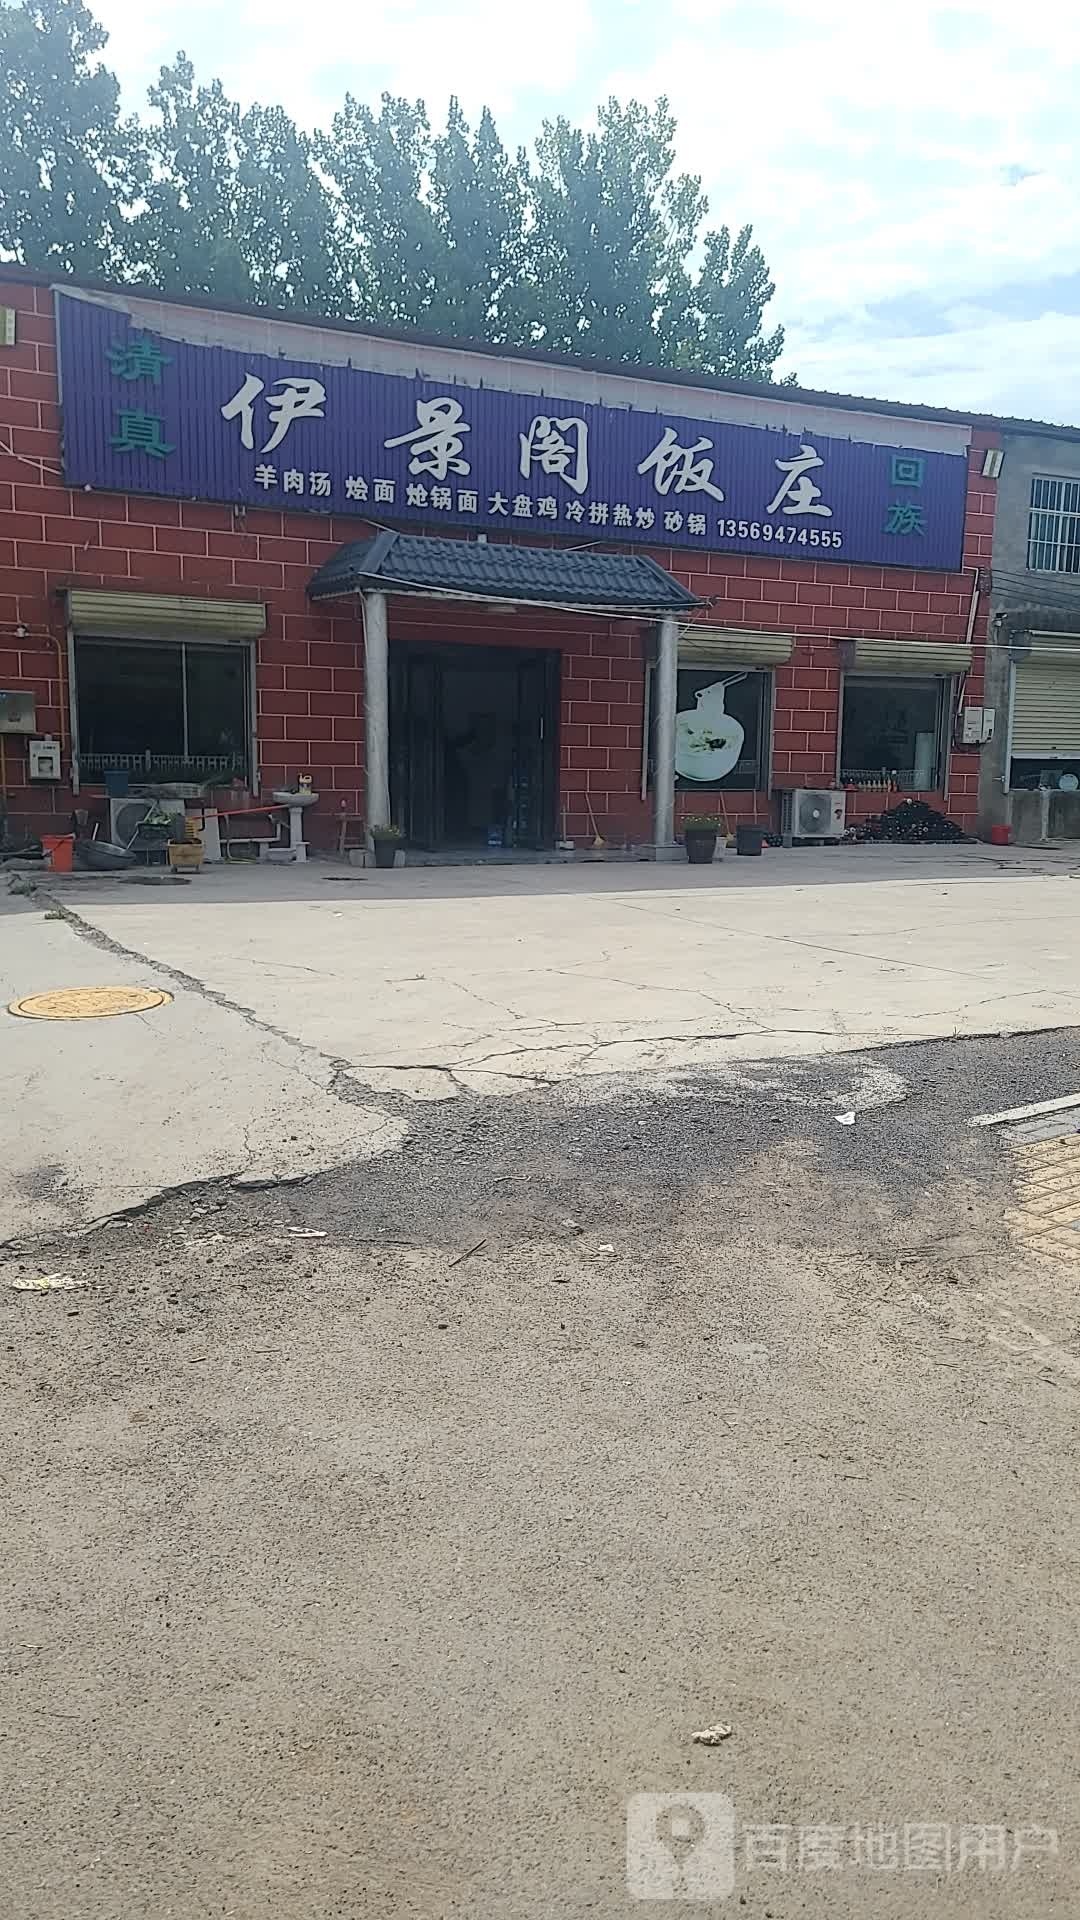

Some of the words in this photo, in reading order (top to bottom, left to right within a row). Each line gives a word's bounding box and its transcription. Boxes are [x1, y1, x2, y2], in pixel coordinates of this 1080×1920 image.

[106, 336, 174, 458] 清真
[221, 374, 833, 516] 伊景阁饭庄
[254, 464, 331, 496] 羊肉汤
[345, 475, 396, 503] 烩面
[488, 491, 558, 520] 大盘鸡
[565, 500, 655, 530] 冷拼热炒
[664, 510, 707, 536] 砂锅
[717, 519, 843, 549] 13569474555
[884, 455, 925, 536] 回族
